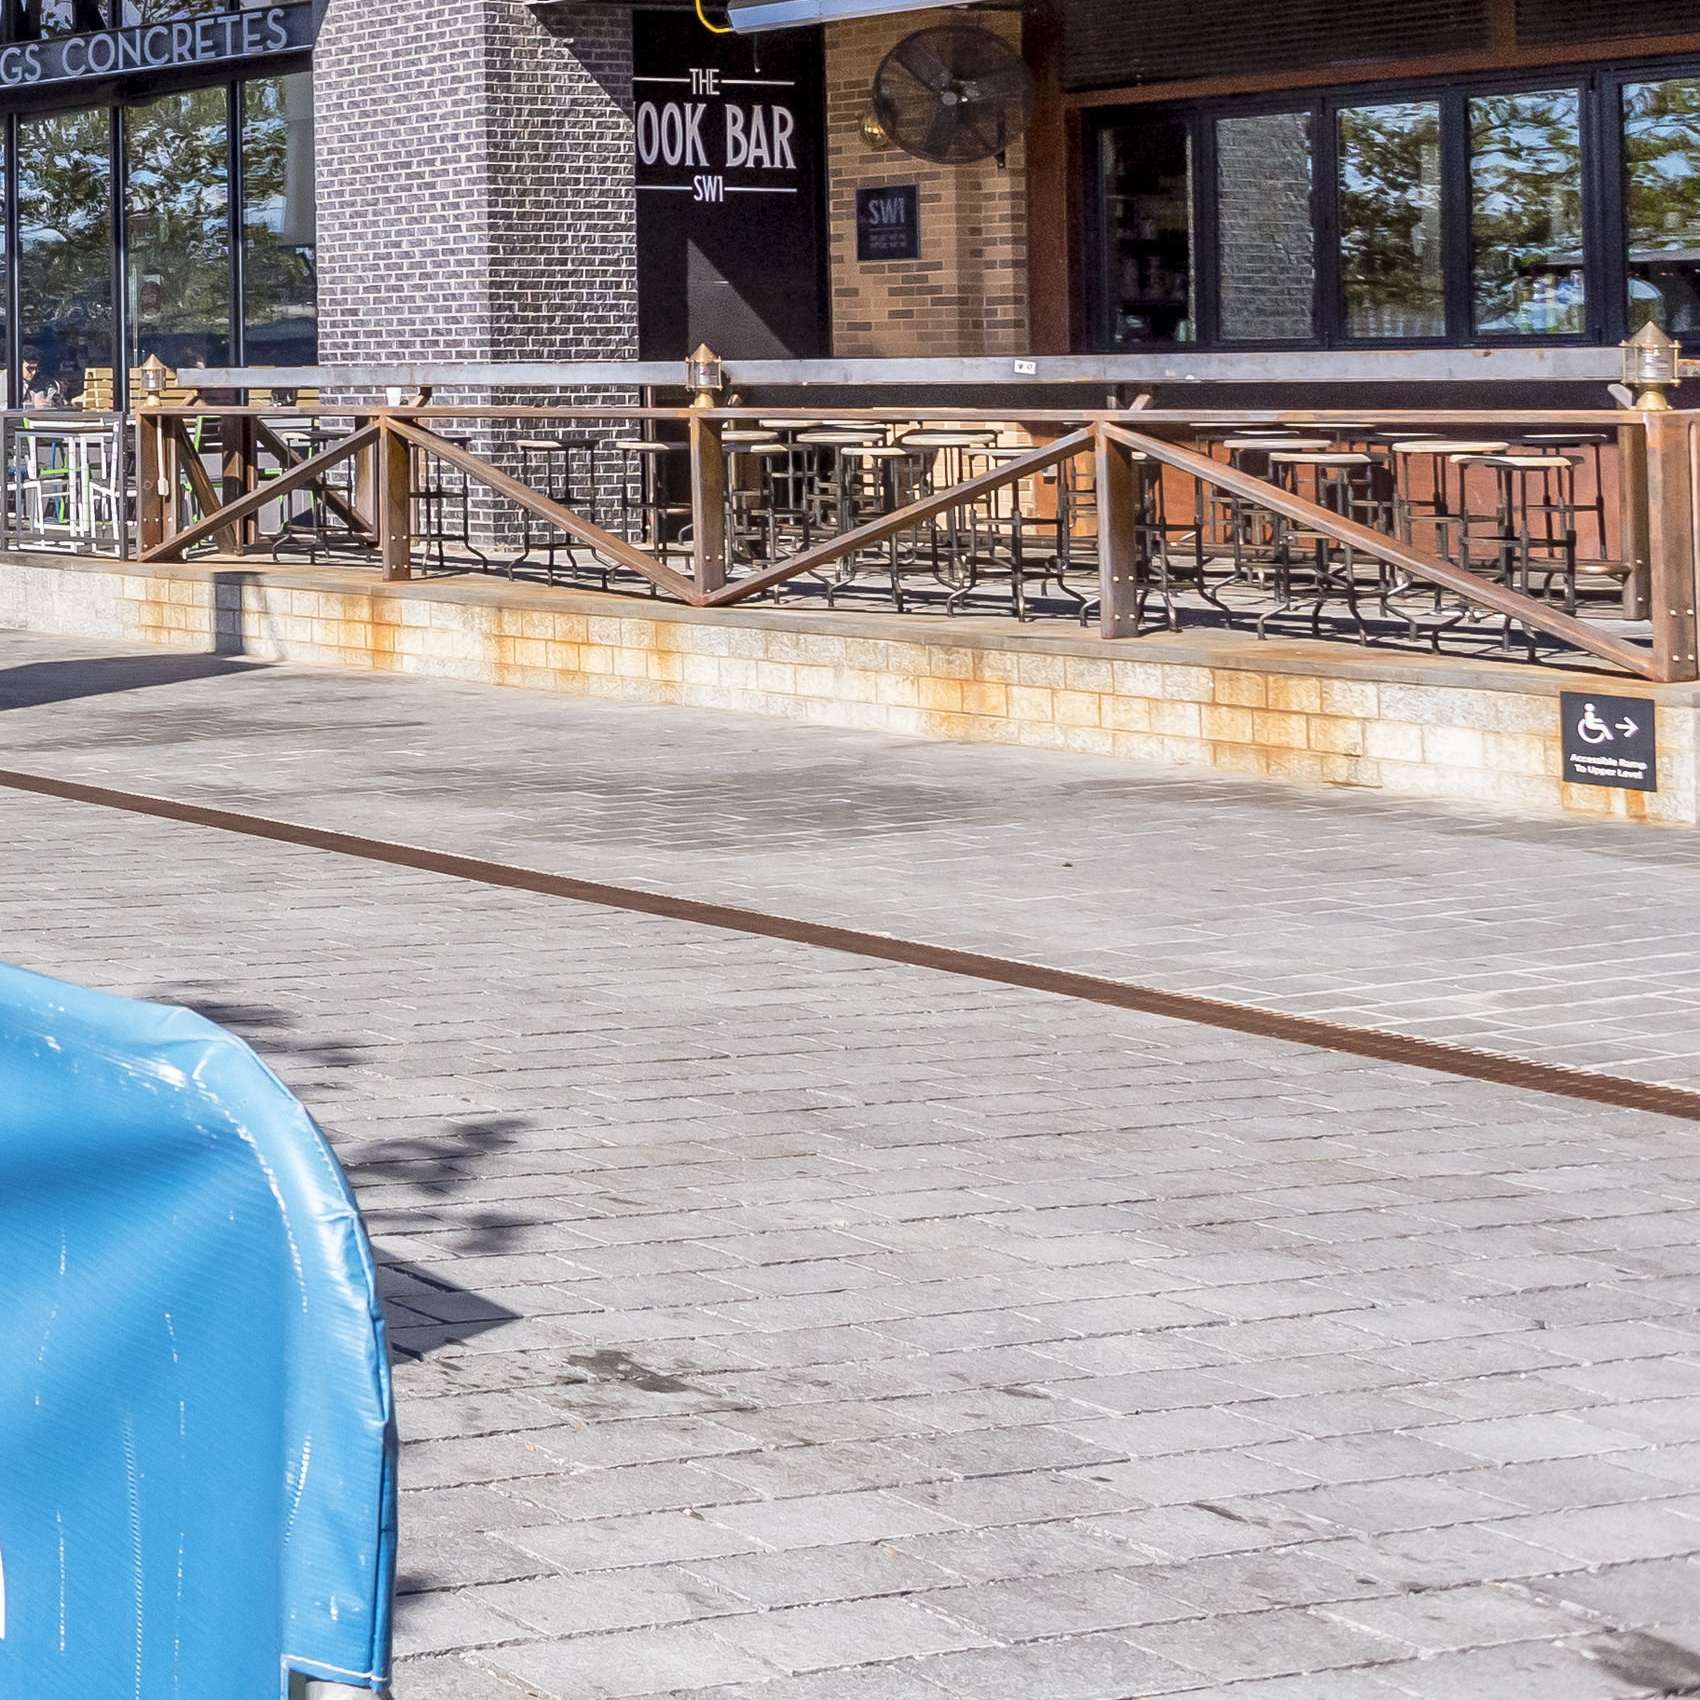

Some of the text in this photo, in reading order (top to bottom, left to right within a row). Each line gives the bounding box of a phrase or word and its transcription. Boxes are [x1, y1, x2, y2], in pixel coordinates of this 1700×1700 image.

[62, 8, 288, 76] CONCRETES
[689, 68, 720, 95] THE
[634, 101, 797, 169] OOK BAR
[693, 175, 724, 202] SW1
[868, 197, 905, 225] SW1
[1587, 766, 1616, 776] Upper
